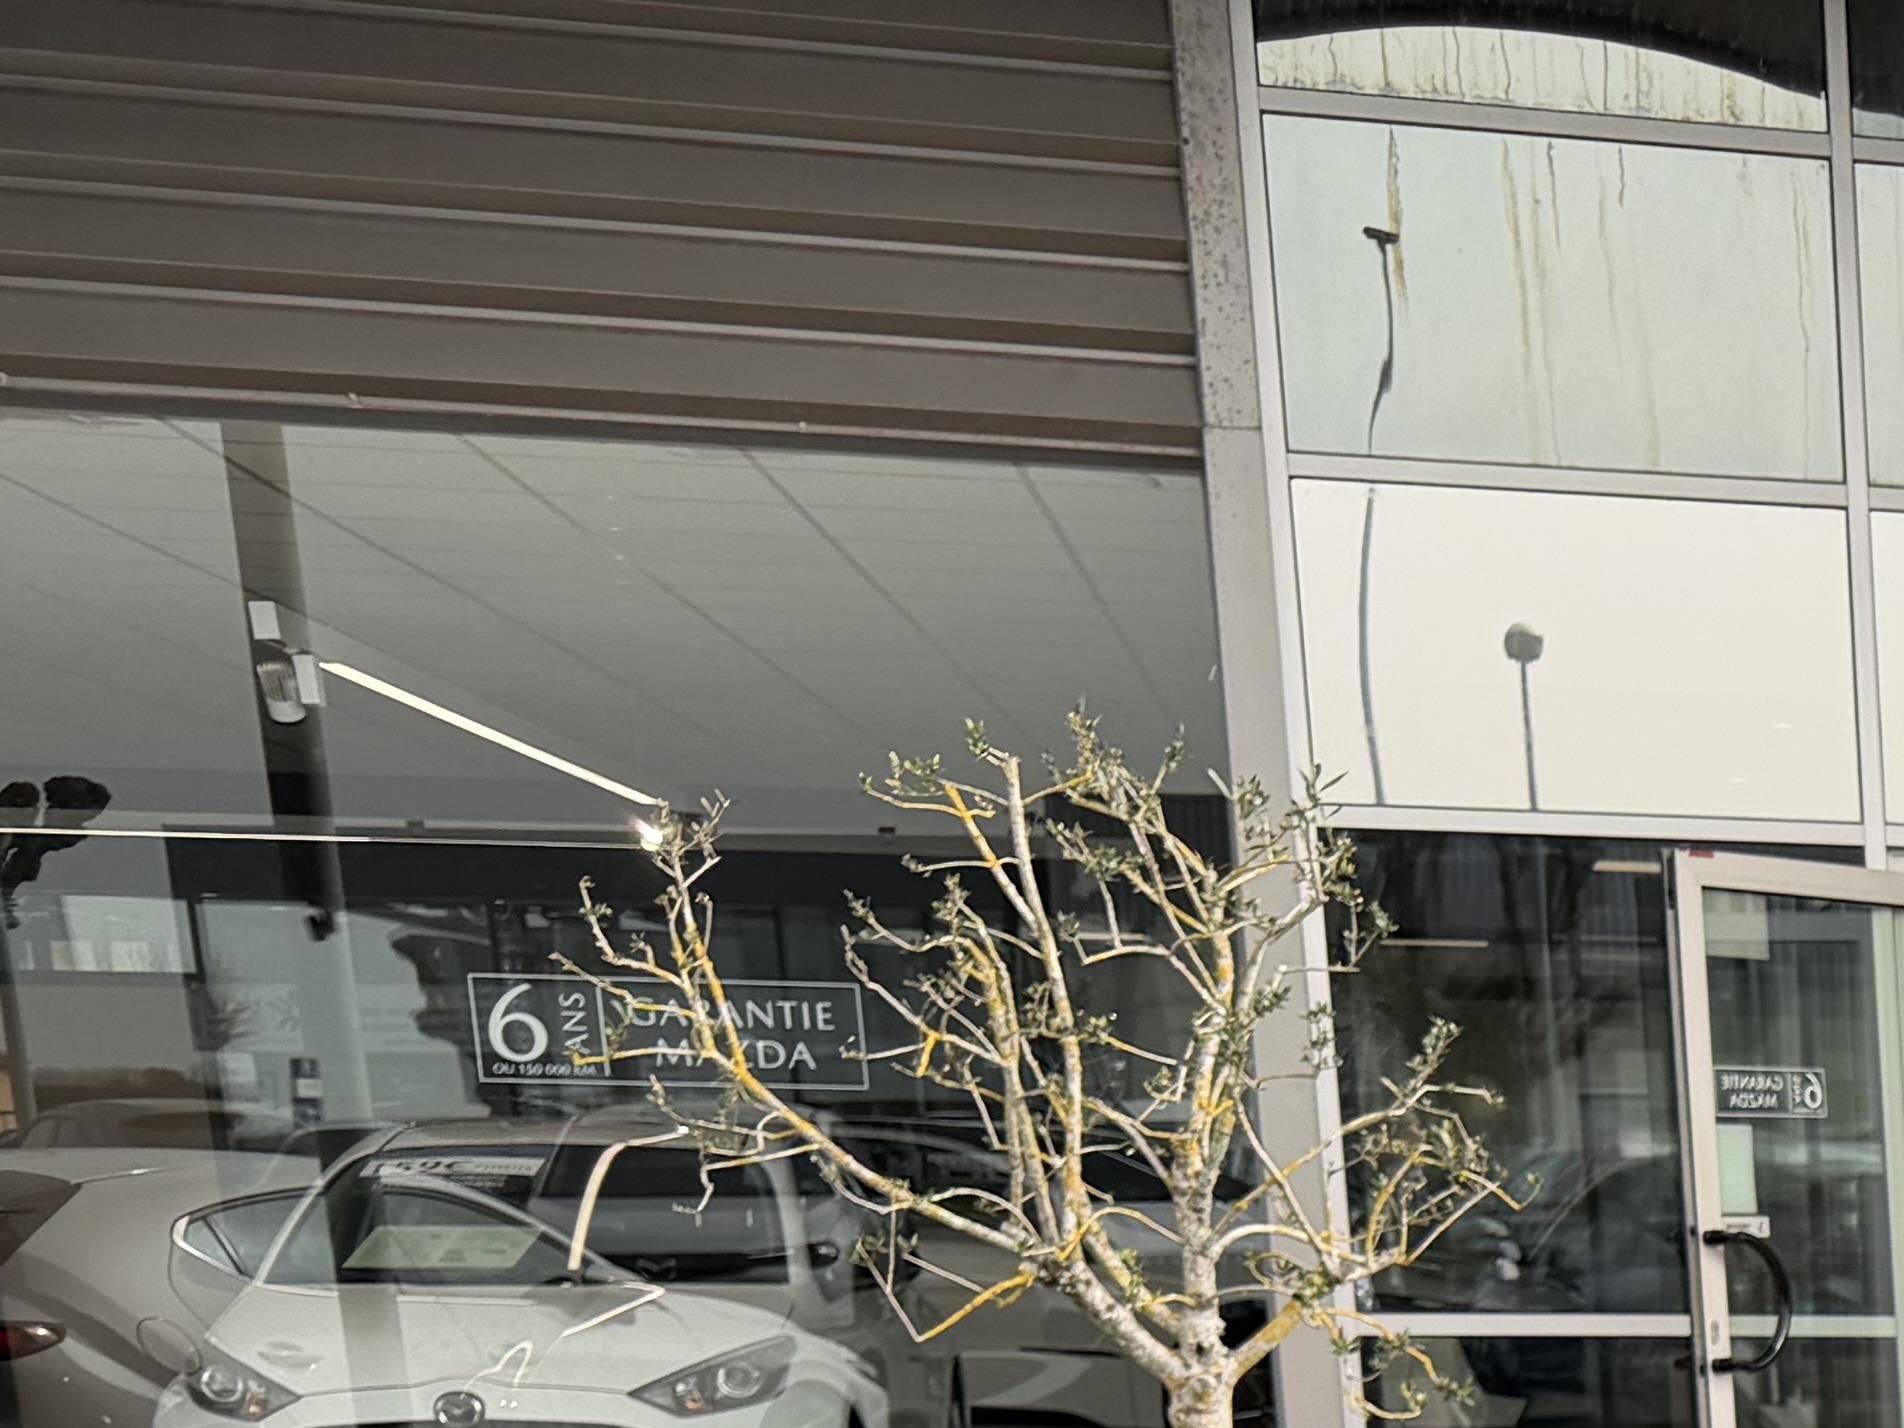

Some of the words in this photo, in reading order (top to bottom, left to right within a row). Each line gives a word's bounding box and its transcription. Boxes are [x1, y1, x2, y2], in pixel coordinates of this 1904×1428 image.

[488, 983, 548, 1062] 6
[558, 992, 591, 1056] ANS
[656, 1037, 817, 1070] MDA
